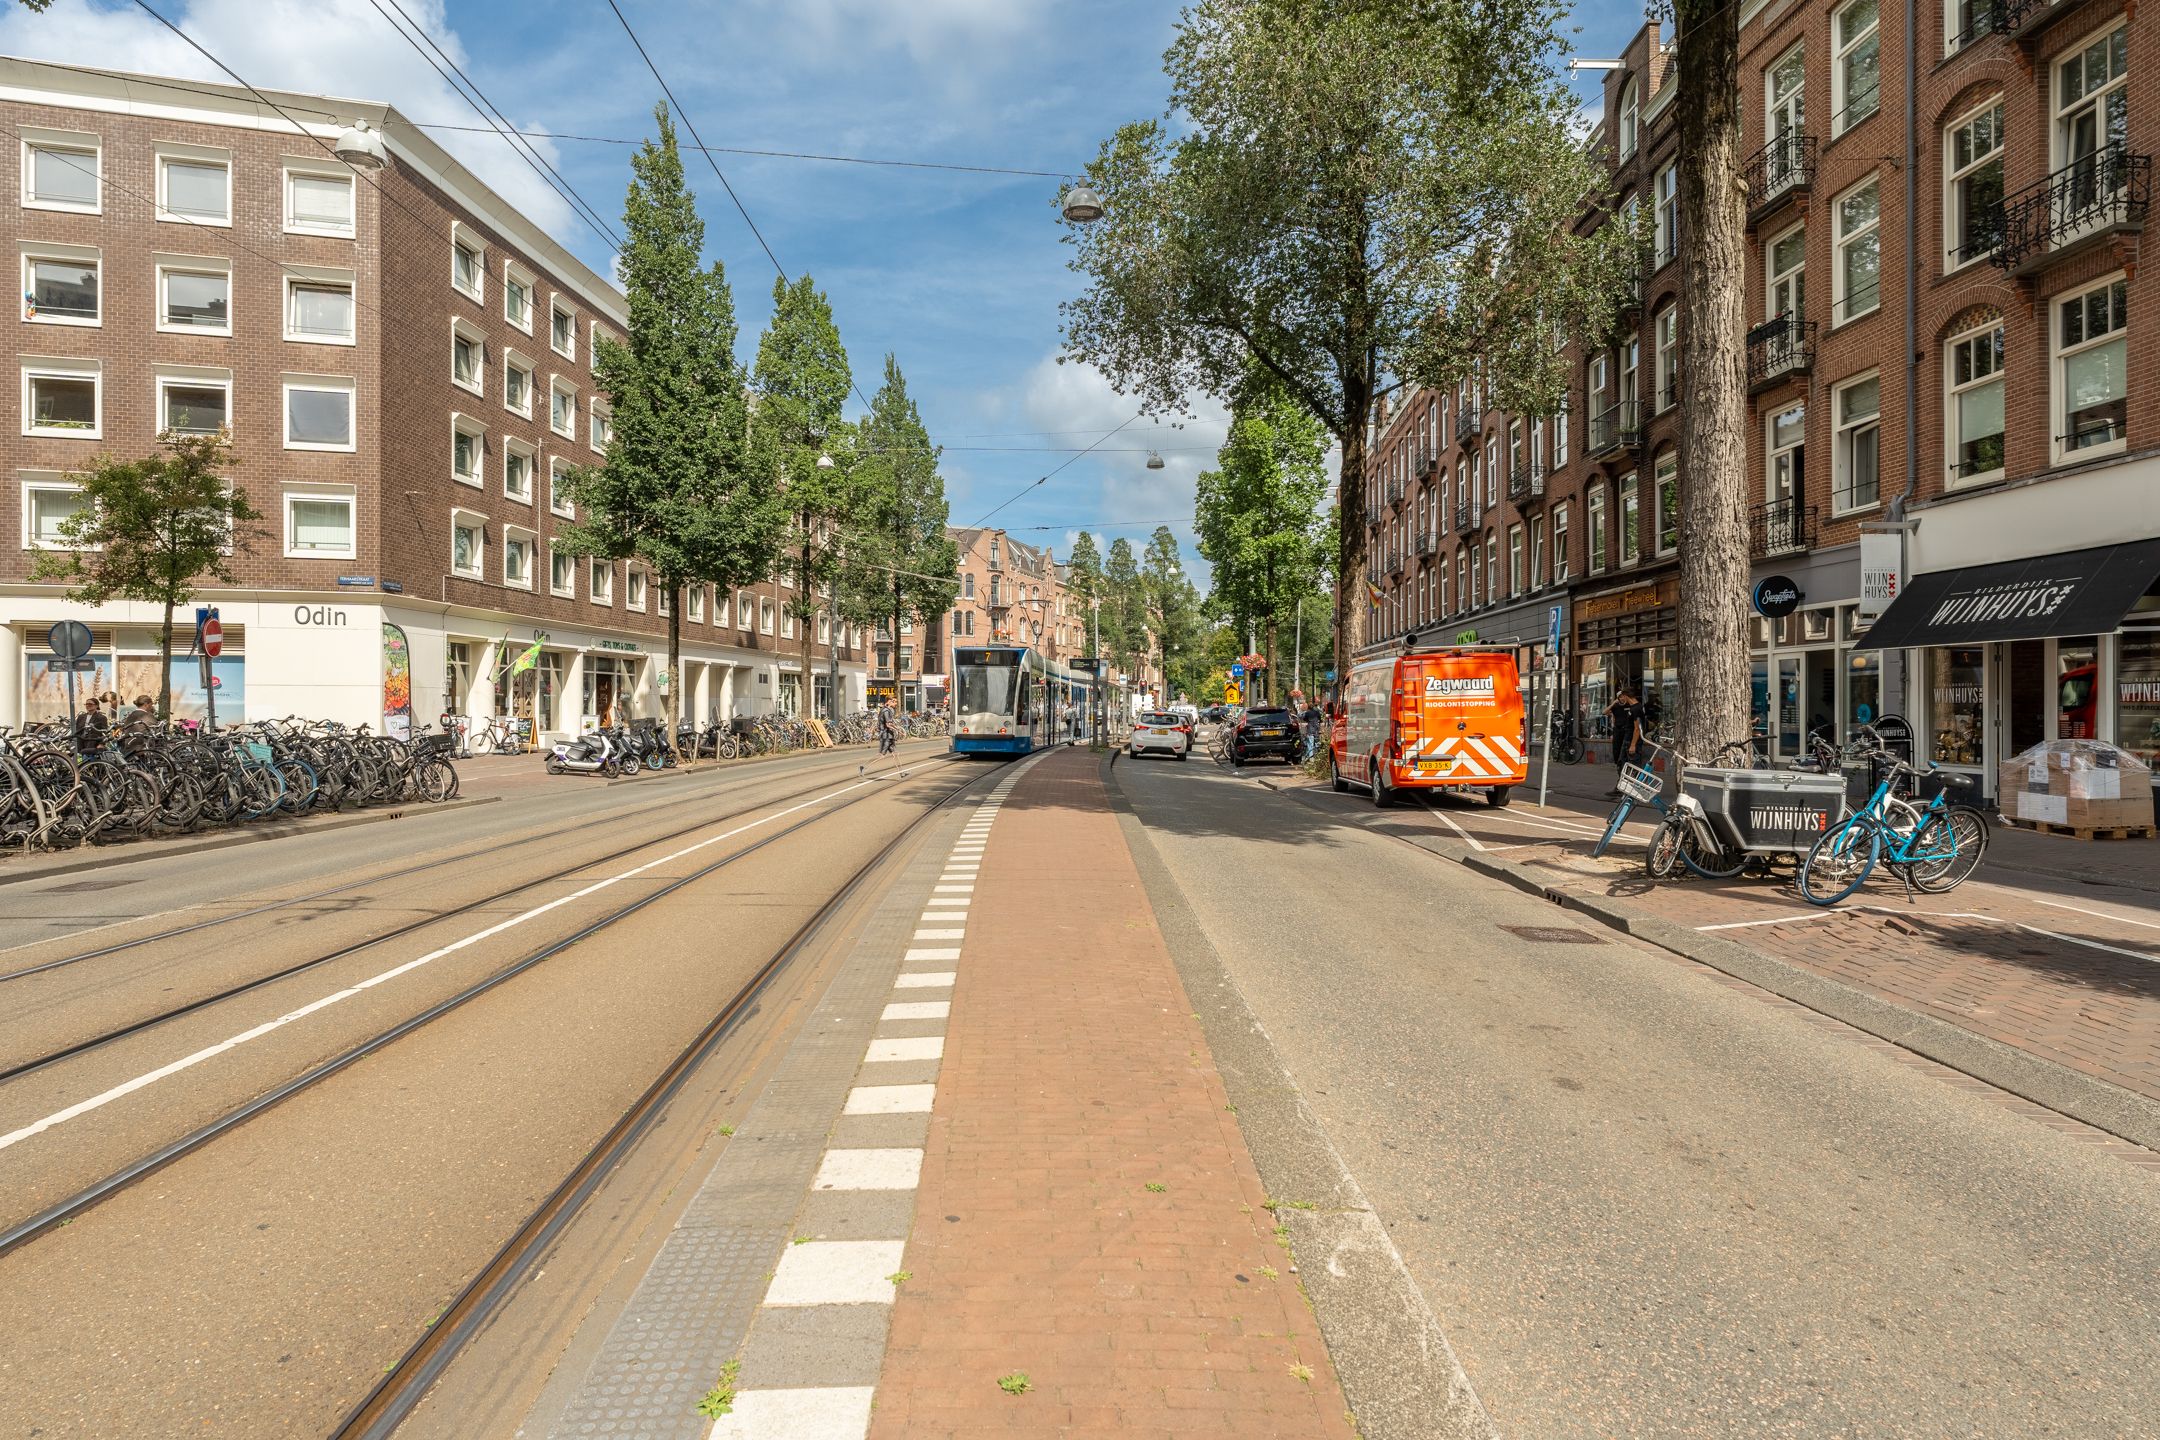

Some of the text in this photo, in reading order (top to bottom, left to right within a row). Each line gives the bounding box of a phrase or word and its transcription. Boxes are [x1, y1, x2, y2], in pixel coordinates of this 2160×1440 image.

[1864, 572, 1888, 585] WIJN
[1974, 579, 2053, 594] BILDERDIJK
[1864, 586, 1888, 599] HUYS
[294, 605, 347, 626] Odin
[1928, 586, 2059, 627] WIJNHUYS
[985, 652, 991, 662] 7
[1425, 674, 1494, 695] Zegwaard
[2120, 683, 2160, 702] WIJNH
[1933, 687, 1979, 704] WIJNHUYS
[1750, 811, 1819, 831] WIJNHUYS
